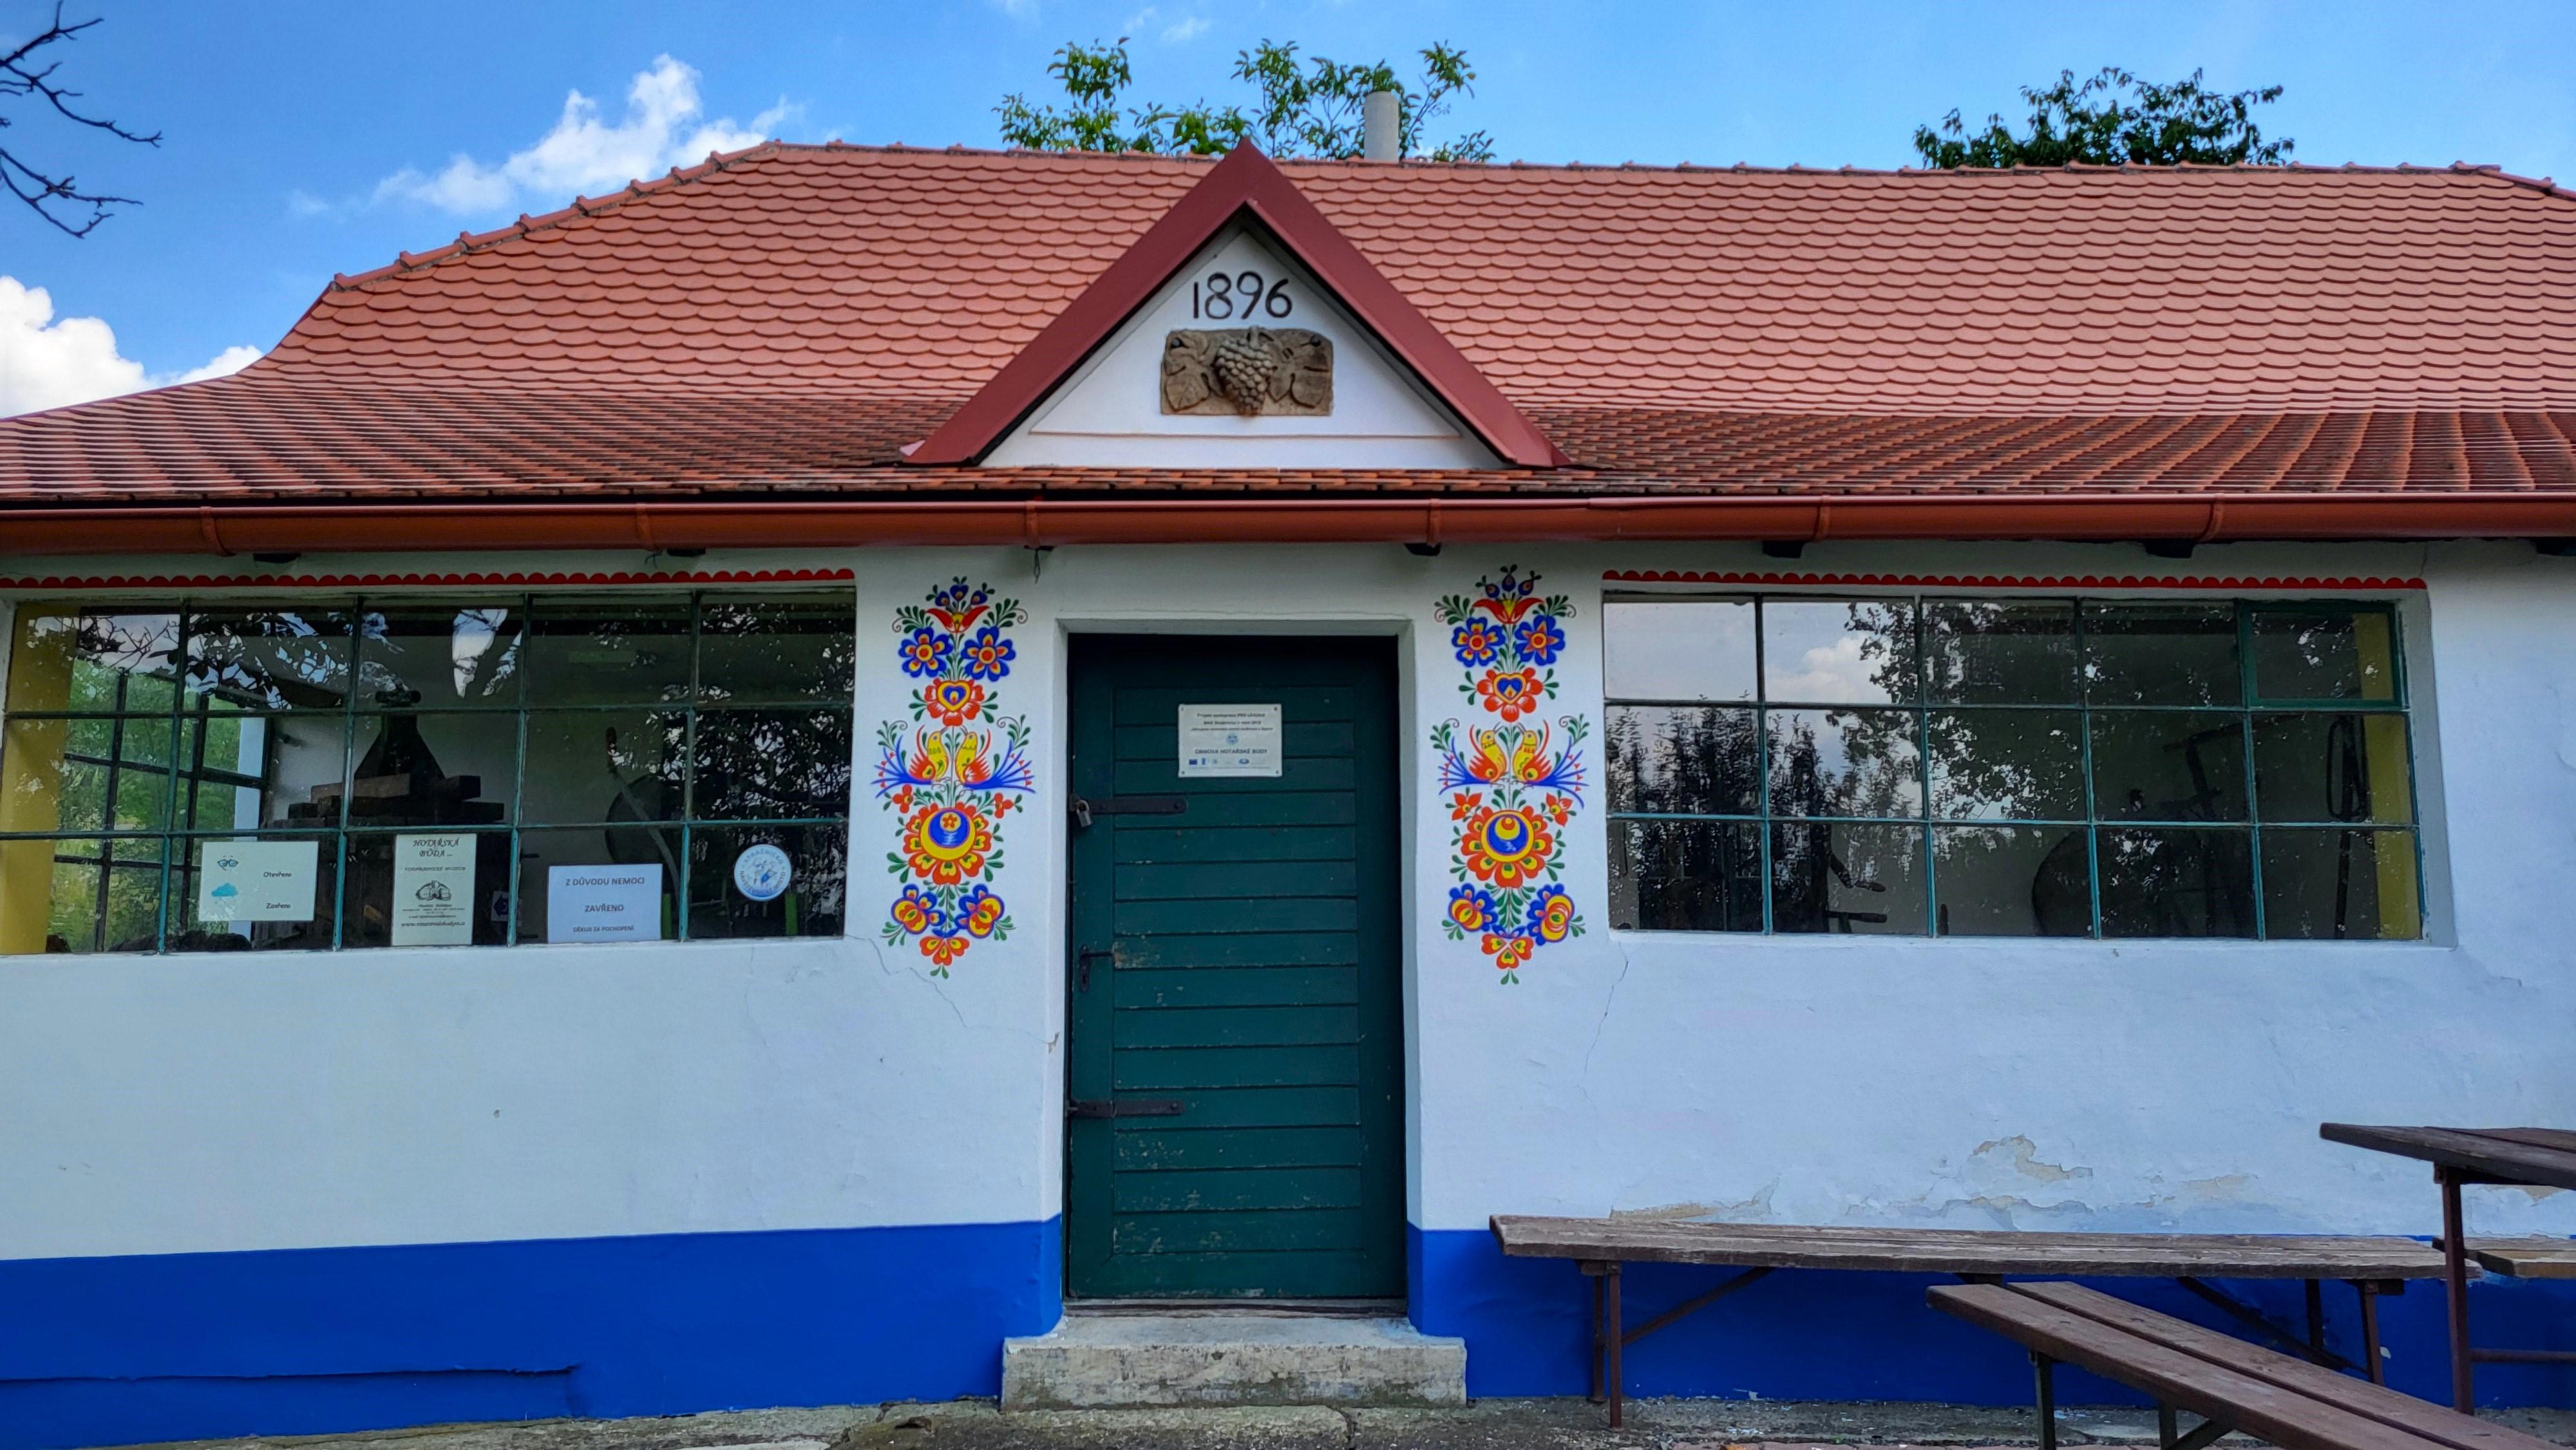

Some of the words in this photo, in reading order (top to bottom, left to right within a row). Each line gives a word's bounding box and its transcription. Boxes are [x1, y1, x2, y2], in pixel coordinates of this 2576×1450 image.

[1193, 270, 1293, 319] 1896
[412, 837, 460, 847] HOTAŘSKÁ
[573, 876, 609, 886] DŮVODU
[611, 876, 645, 885] NEMOCI
[585, 903, 624, 912] ZAVŘENO
